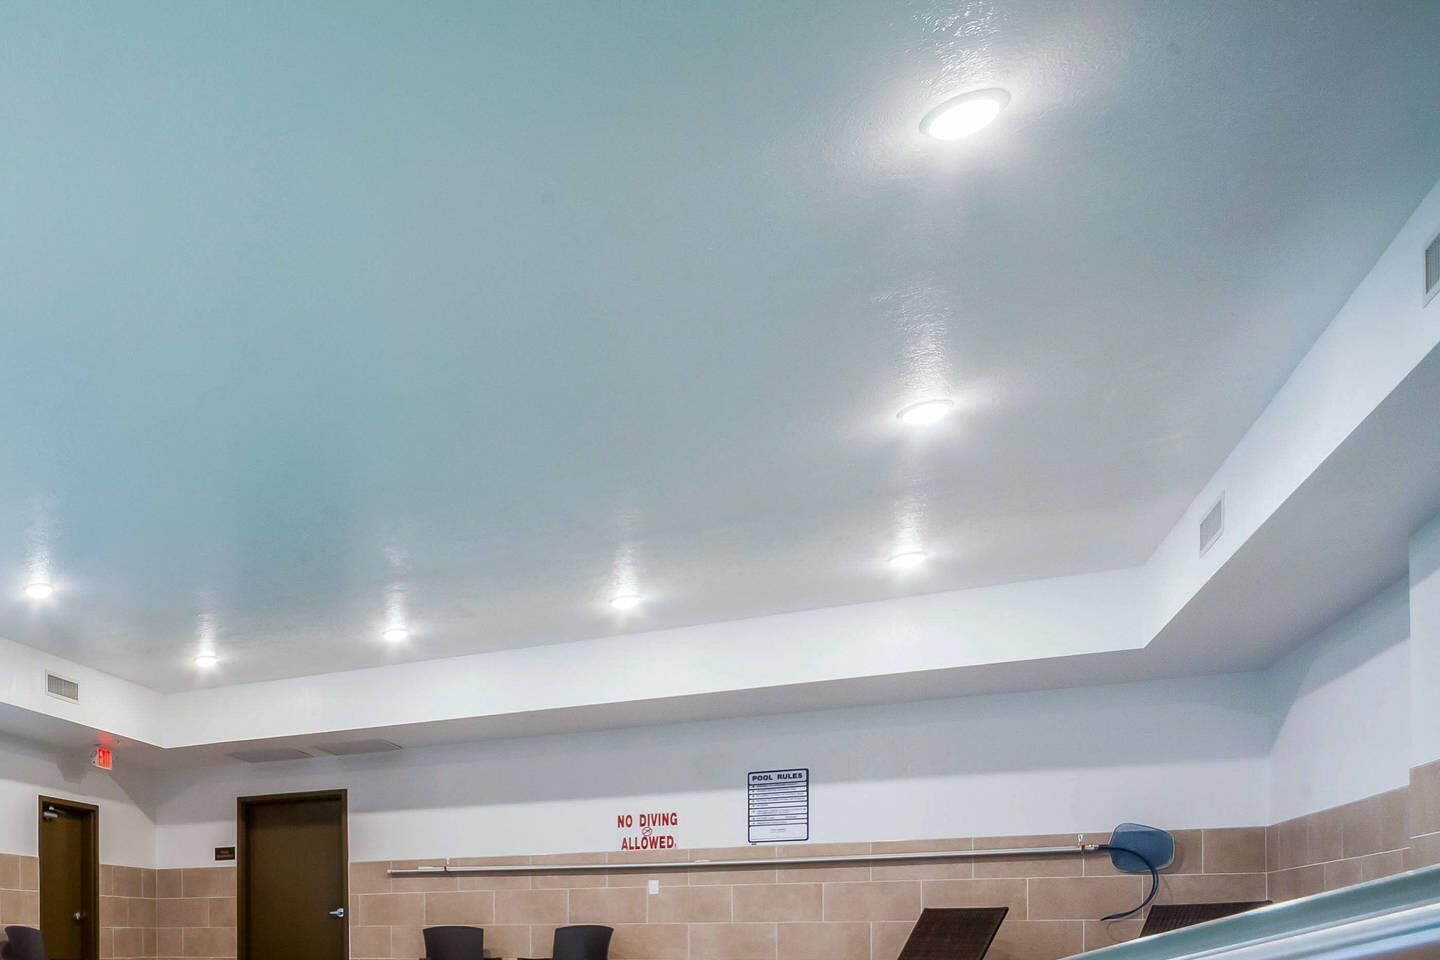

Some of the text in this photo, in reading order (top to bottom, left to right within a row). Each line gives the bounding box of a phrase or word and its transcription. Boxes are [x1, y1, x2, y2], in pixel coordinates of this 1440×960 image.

[617, 813, 678, 828] NO DIVING
[621, 835, 674, 850] ALLOWED
